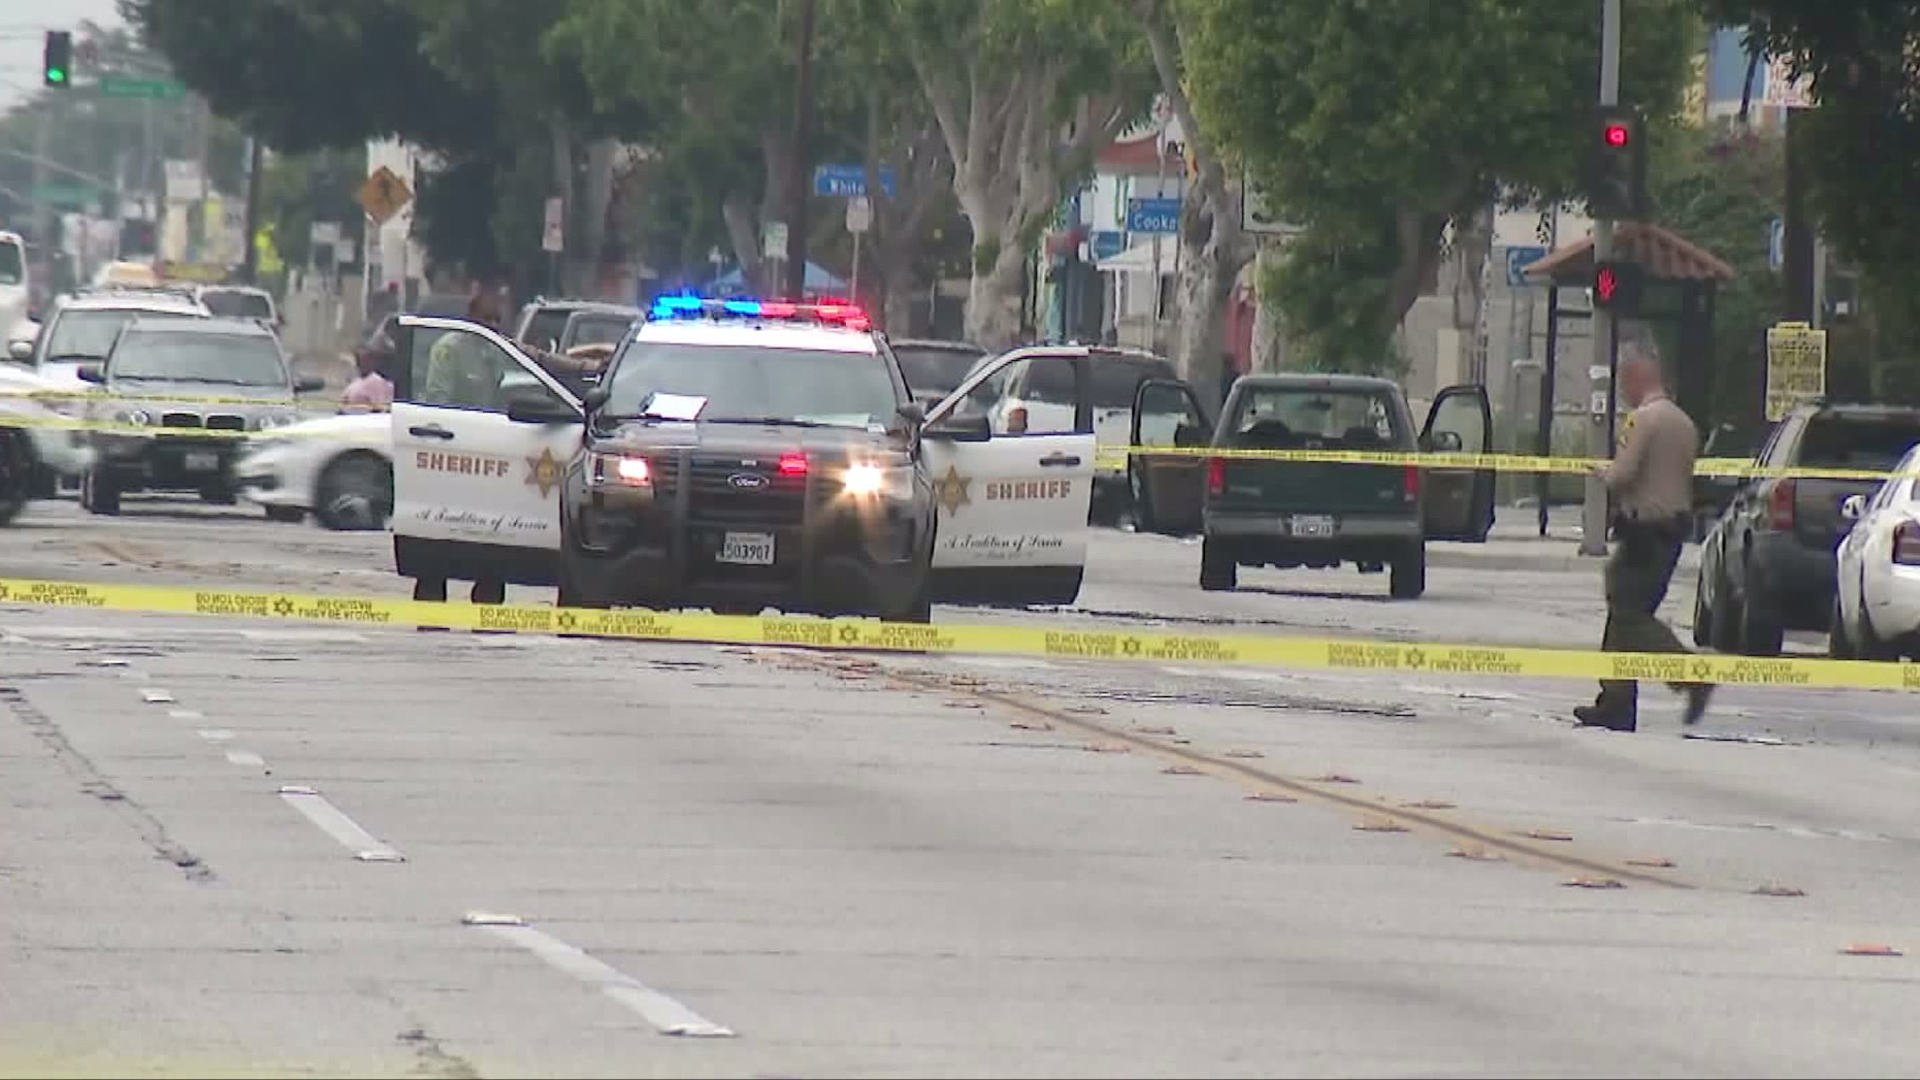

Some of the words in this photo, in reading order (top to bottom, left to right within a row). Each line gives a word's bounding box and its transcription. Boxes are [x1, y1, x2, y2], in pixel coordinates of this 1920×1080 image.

[417, 452, 509, 476] SHERIFF
[986, 480, 1071, 500] SHERIFF
[434, 508, 487, 525] Tradition
[491, 515, 505, 532] of
[960, 534, 1009, 549] Tradition
[1012, 535, 1025, 552] of
